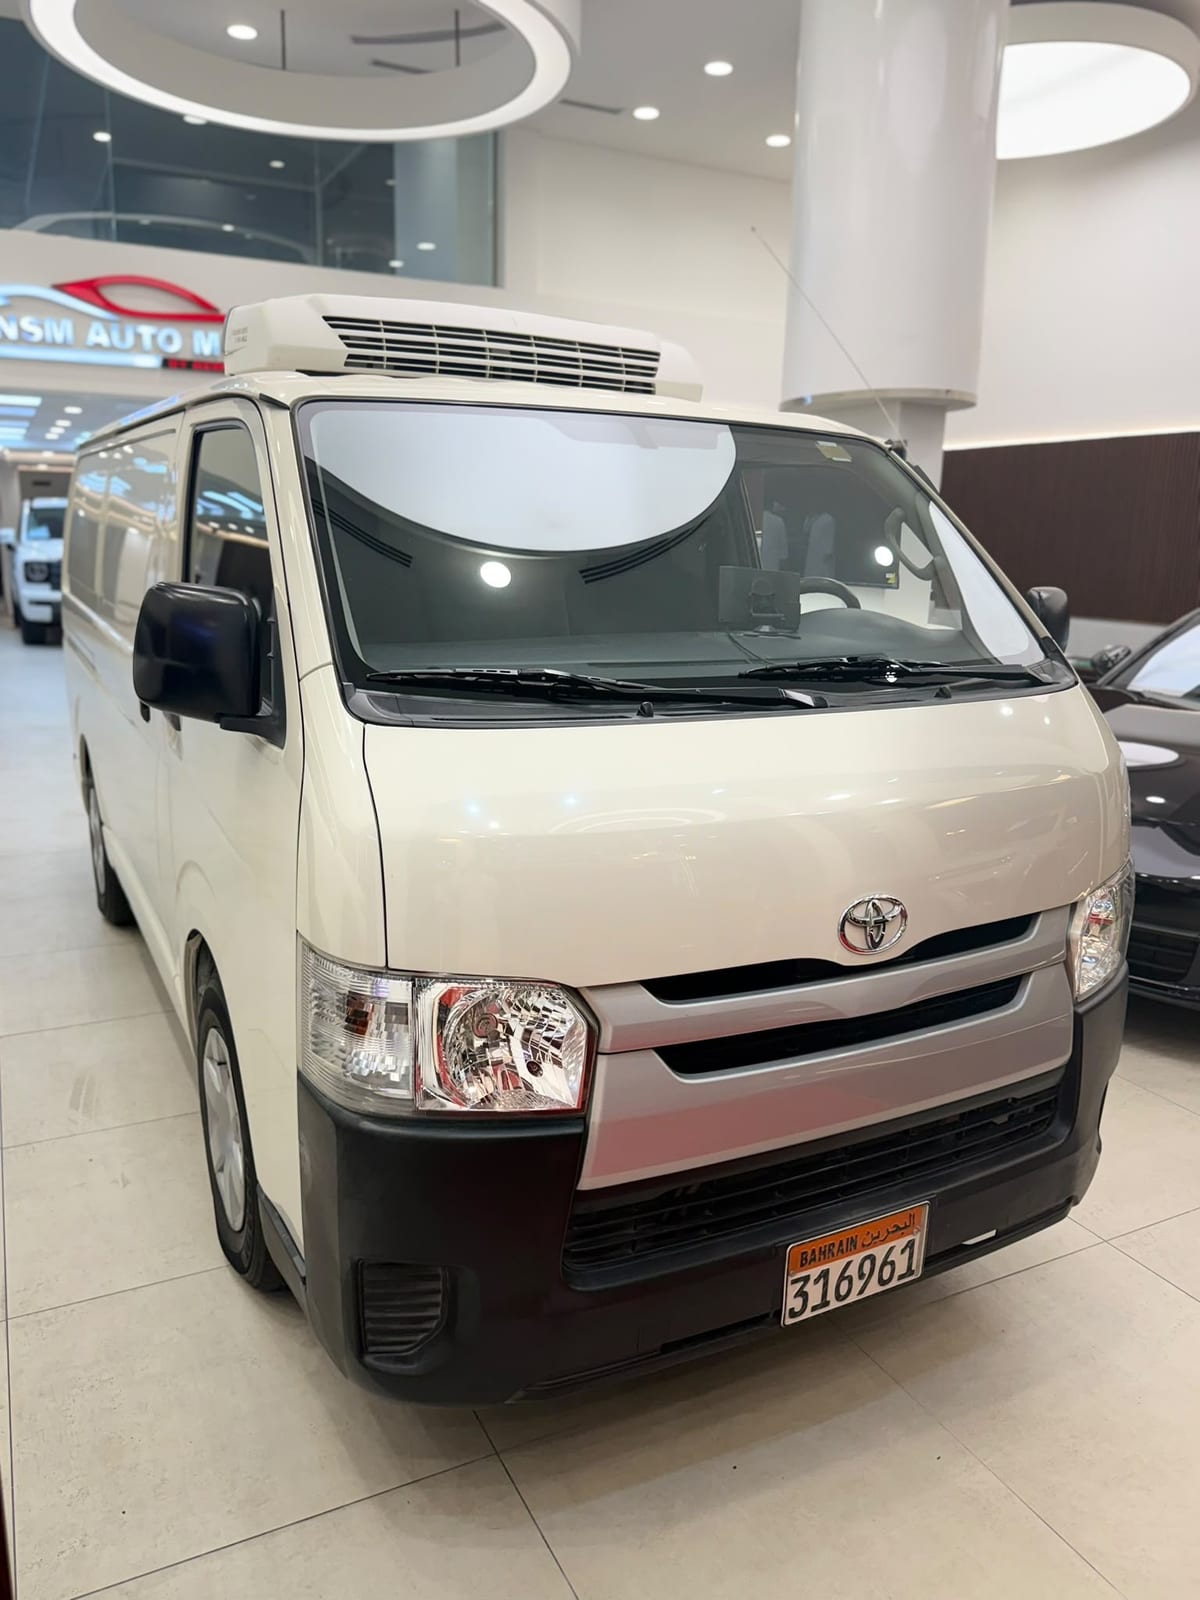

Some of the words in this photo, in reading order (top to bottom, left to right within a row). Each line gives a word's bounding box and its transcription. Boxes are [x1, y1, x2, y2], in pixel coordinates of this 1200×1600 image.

[86, 320, 183, 354] AUTO
[861, 1212, 916, 1249] البحرين
[799, 1234, 859, 1268] BAHRAIN
[788, 1238, 917, 1320] 316961
